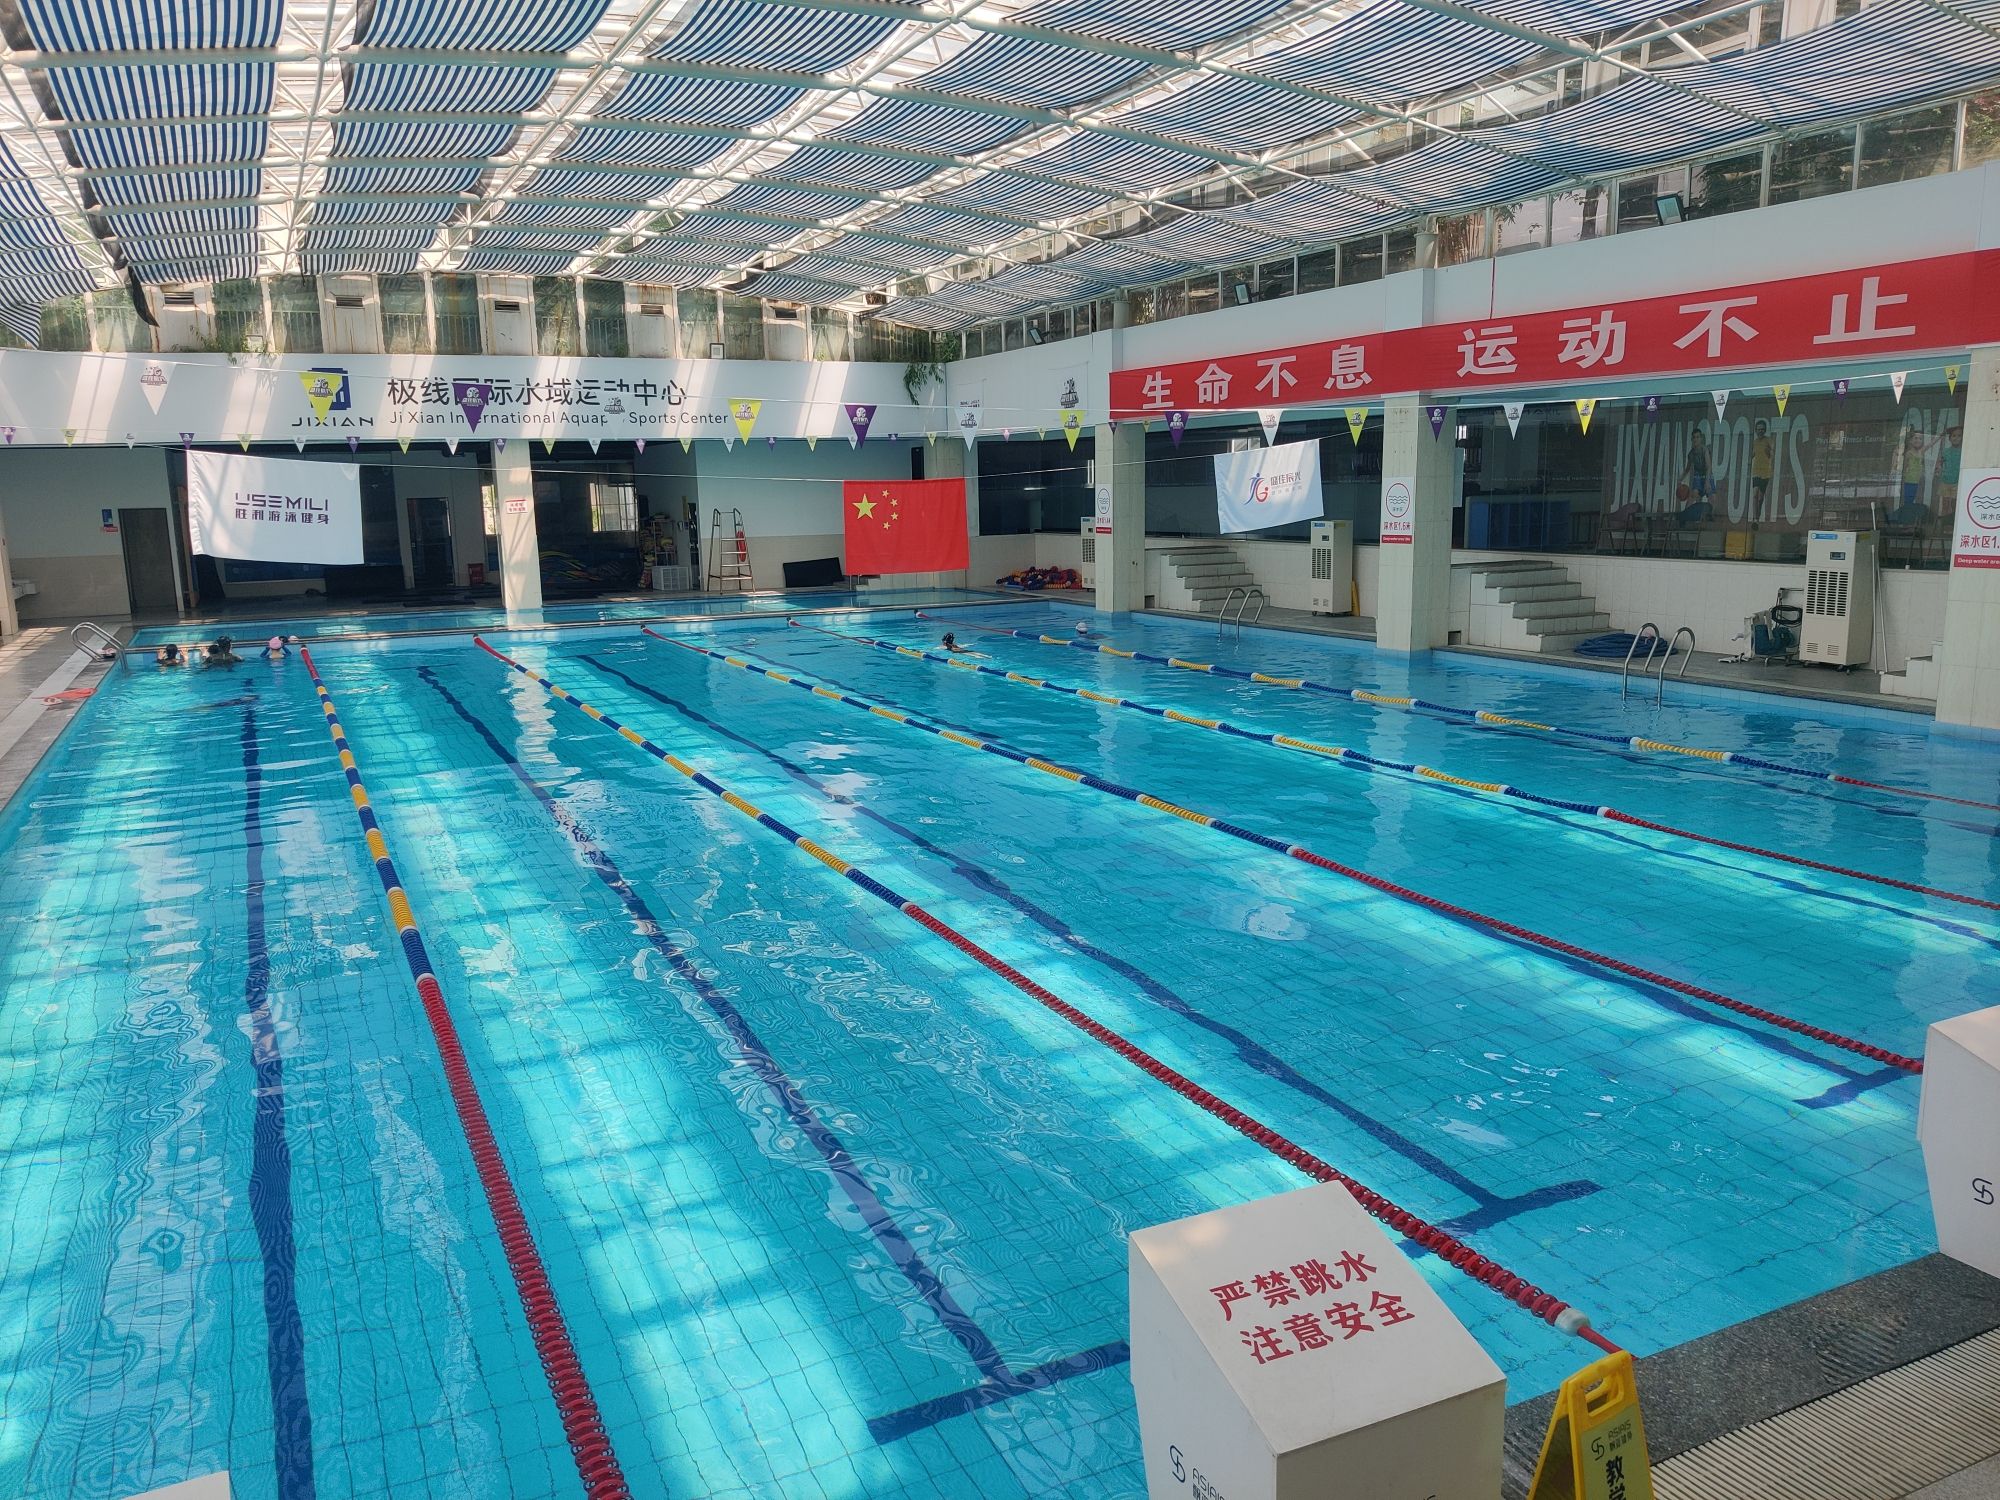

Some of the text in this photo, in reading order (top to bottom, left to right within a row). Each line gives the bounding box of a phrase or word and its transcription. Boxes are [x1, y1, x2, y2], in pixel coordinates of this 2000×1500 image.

[1141, 276, 1916, 410] 生命不息 运动不止
[387, 377, 687, 406] 极线际水域运动中心
[390, 411, 402, 424] Ji
[408, 411, 445, 424] Xian
[450, 411, 555, 424] Inernational
[629, 411, 677, 427] Sports
[680, 411, 728, 424] Center
[235, 492, 328, 511] USEMILI
[1210, 1250, 1377, 1322] 严禁跳水
[1240, 1290, 1416, 1365] 注意安全
